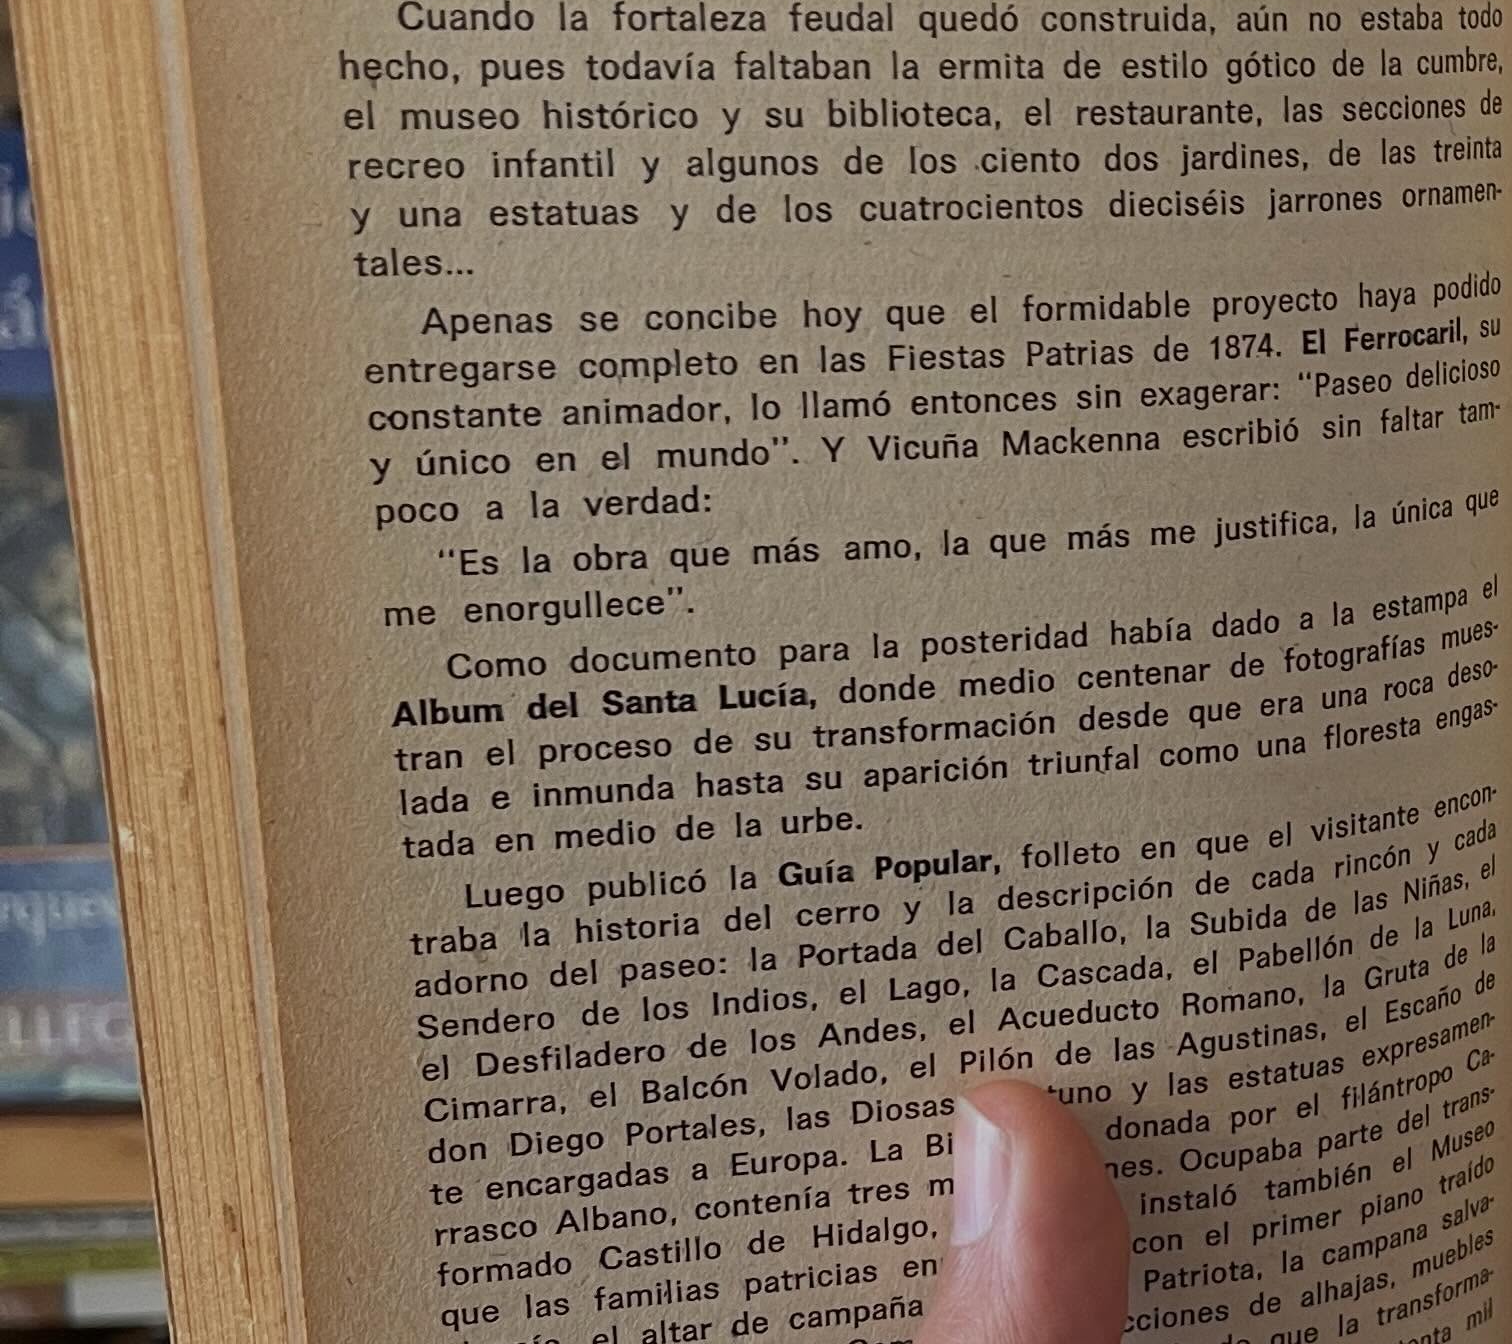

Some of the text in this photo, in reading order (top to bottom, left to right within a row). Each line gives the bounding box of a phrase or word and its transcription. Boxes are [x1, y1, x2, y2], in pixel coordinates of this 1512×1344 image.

[363, 314, 1502, 390] entregarse completo en las Fiestas Patrias de 1874. El Ferrocaril, su
[368, 456, 393, 487] y
[414, 447, 512, 478] único
[534, 451, 578, 474] en
[600, 440, 631, 472] el
[819, 435, 847, 464] Y
[866, 432, 980, 463] Vicuña
[1001, 425, 1162, 458] Mackenna
[1181, 415, 1300, 450] escribió
[1321, 412, 1362, 441] sin
[1379, 404, 1446, 436] faltar
[1457, 400, 1502, 426] tam-
[390, 619, 1500, 729] Album del Santa Lucía, donde medio centenar de fotografías mues-
[463, 784, 1498, 912] Luego publicó la Guía Popular, folleto en que el visitante encon-
[420, 930, 1497, 1083] el Desfiladero de los Andes, el Acueducto Romano, la Gruta de la
